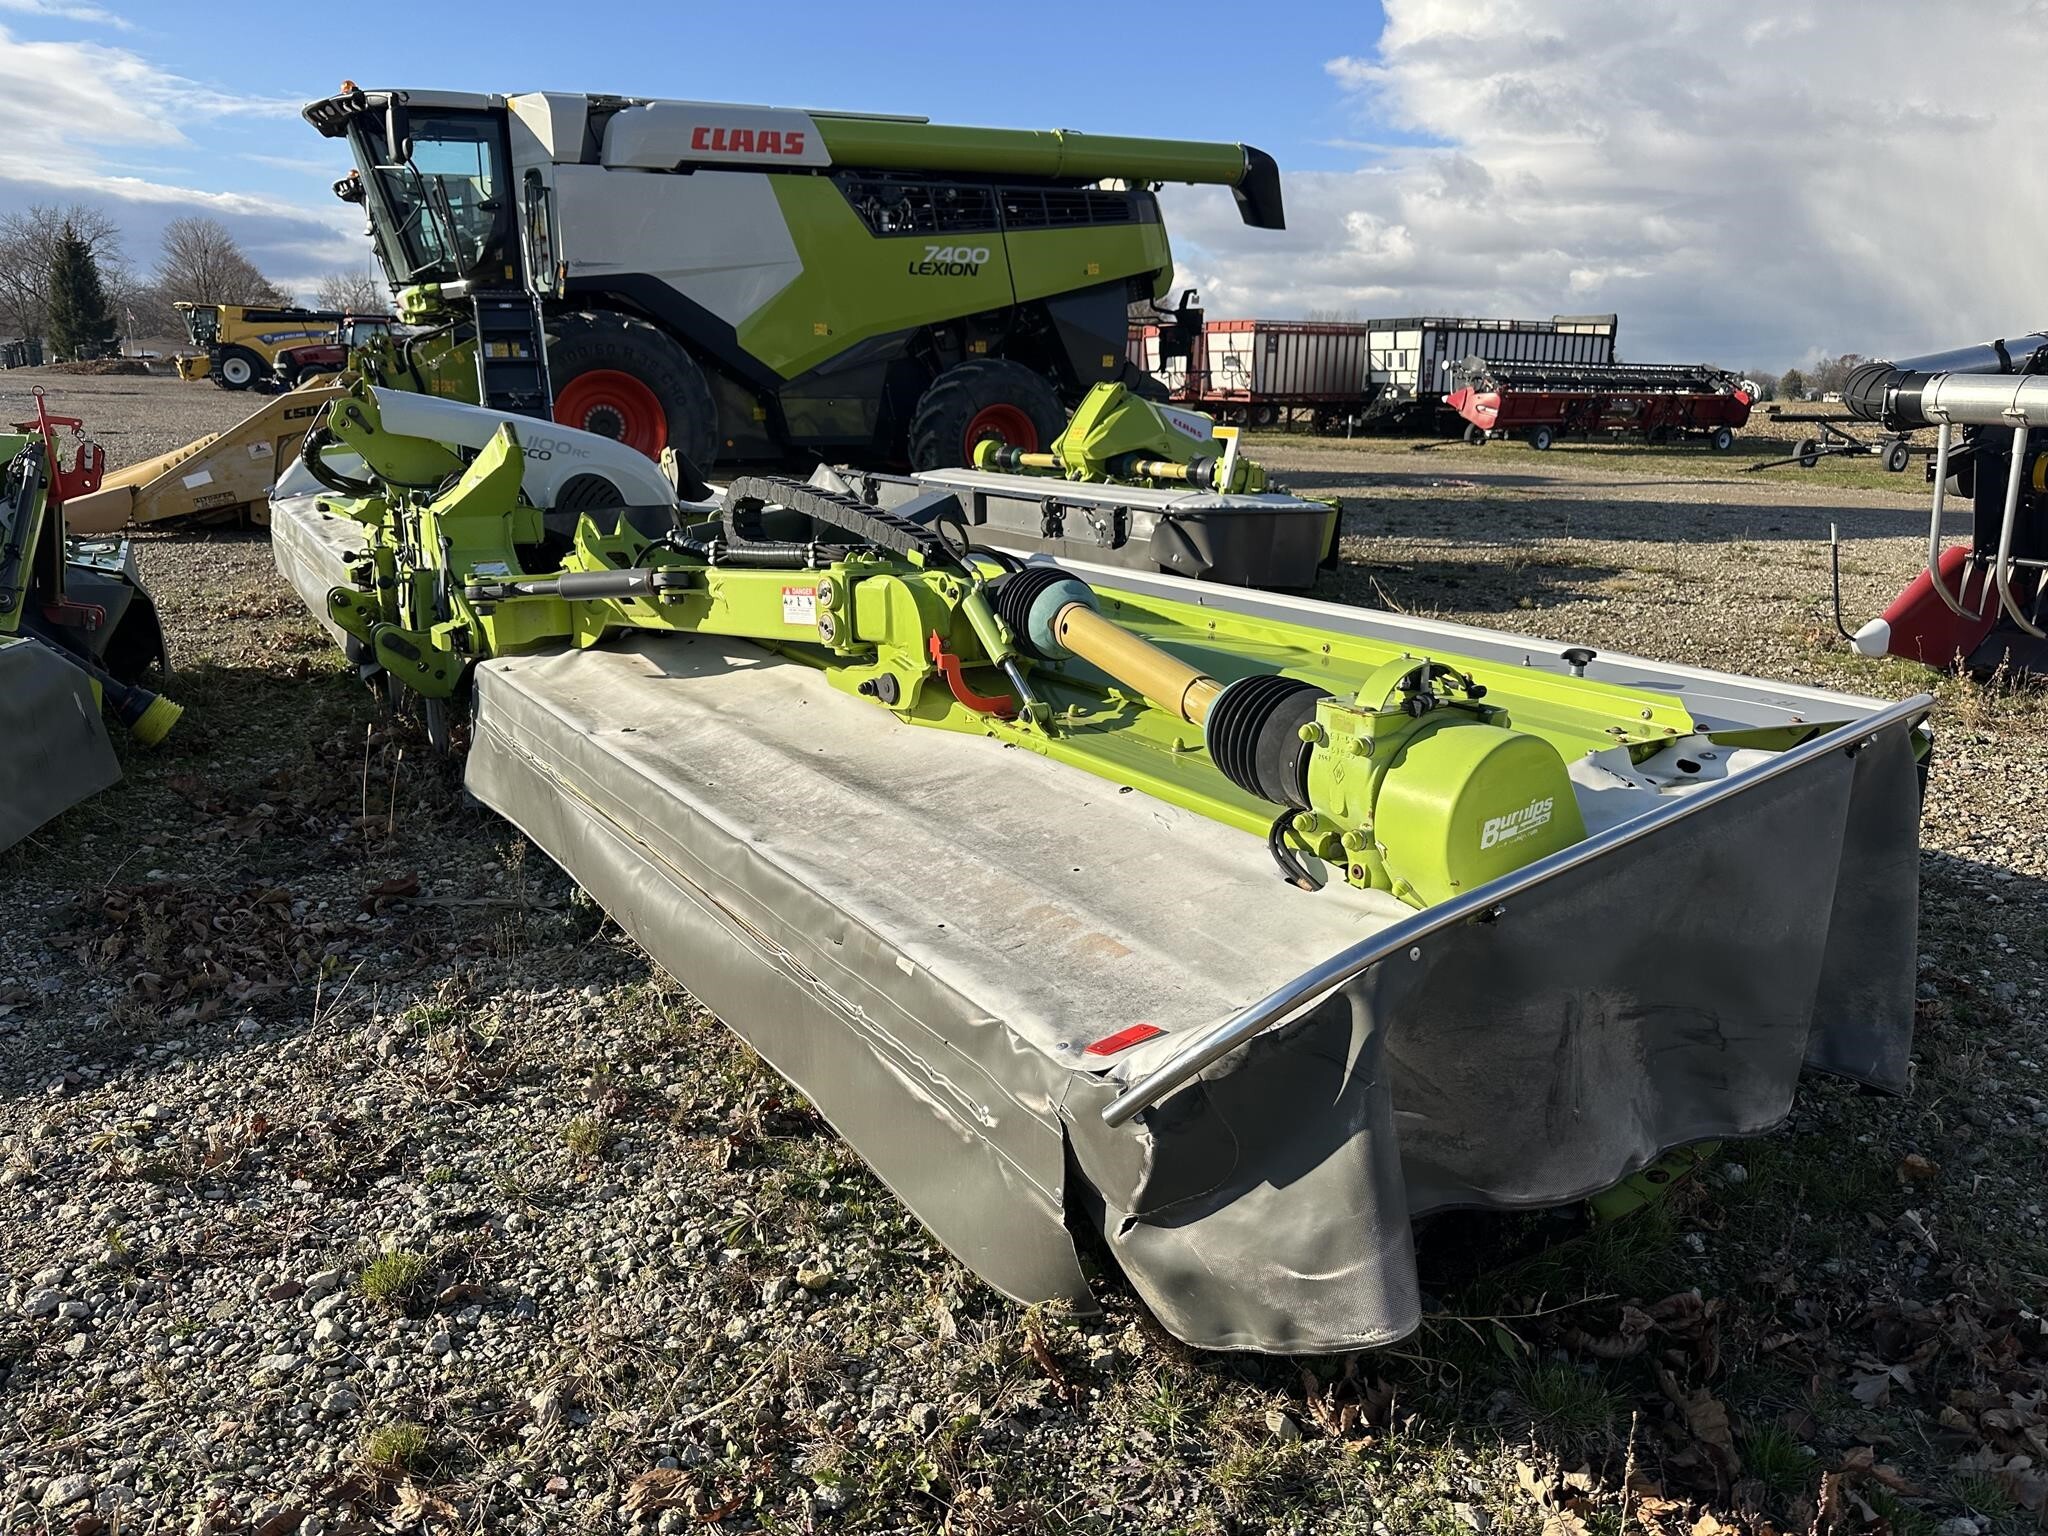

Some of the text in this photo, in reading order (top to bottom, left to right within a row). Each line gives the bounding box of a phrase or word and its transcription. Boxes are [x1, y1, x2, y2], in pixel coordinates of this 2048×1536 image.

[691, 127, 805, 154] CLAAS
[924, 246, 990, 264] 7400
[908, 262, 979, 277] LEXION
[1172, 417, 1203, 438] CLAAS
[791, 587, 813, 596] DANGER
[1481, 796, 1553, 850] Burnips
